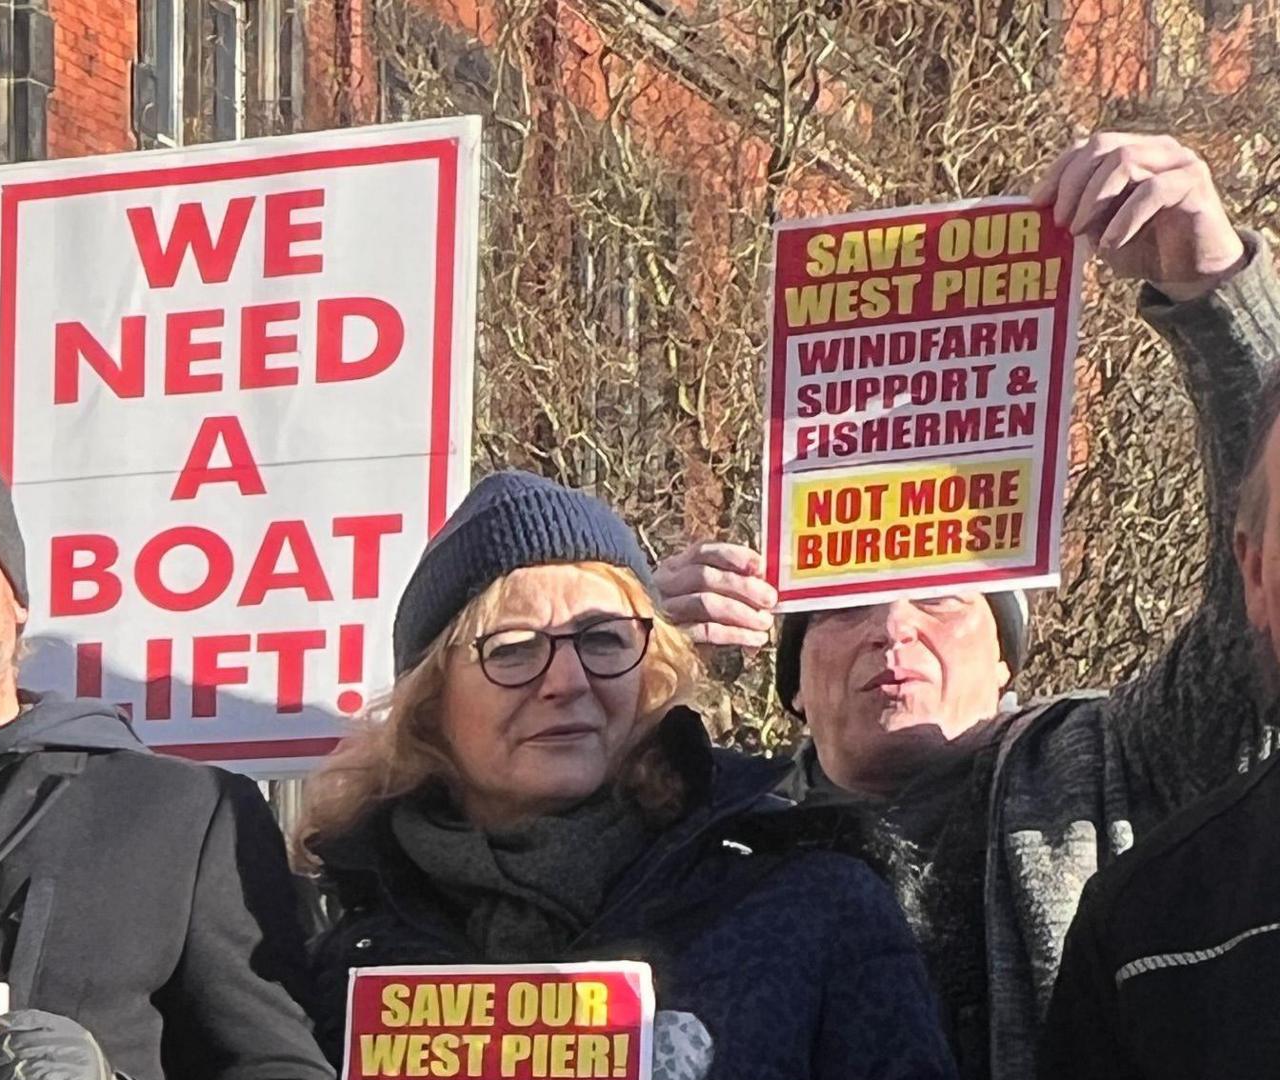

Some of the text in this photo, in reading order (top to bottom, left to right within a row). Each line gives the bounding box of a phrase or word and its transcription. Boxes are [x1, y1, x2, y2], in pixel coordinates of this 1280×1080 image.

[126, 188, 325, 289] WE
[806, 210, 1041, 278] SAVE OUR
[785, 257, 1062, 328] WEST PIER!
[54, 297, 405, 405] NEED
[798, 317, 1038, 377] WINDFARM
[797, 364, 1037, 419] SUPPORT &
[171, 416, 267, 501] A
[796, 402, 1035, 460] FISHERMEN
[807, 470, 1020, 528] NOT MORE
[49, 513, 403, 618] BOAT
[797, 512, 1023, 570] BURGERS!!
[381, 981, 608, 1027] SAVE OUR
[360, 1033, 630, 1078] WEST PIER!
